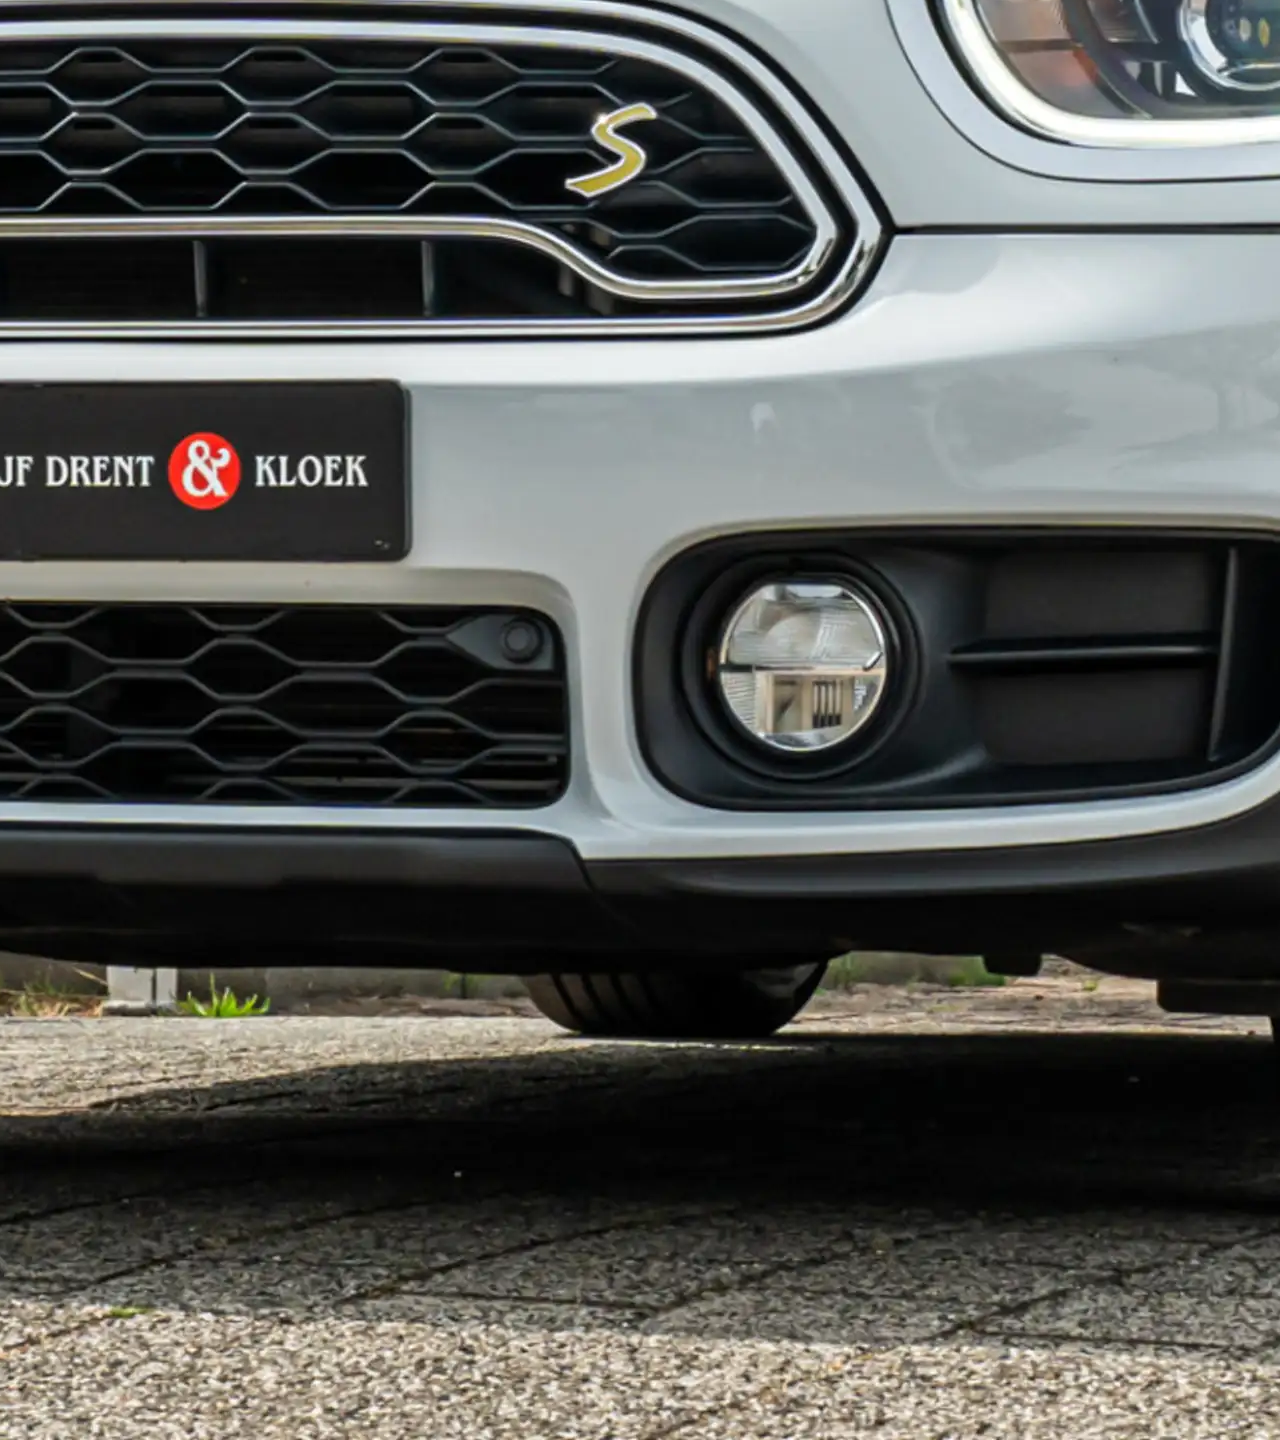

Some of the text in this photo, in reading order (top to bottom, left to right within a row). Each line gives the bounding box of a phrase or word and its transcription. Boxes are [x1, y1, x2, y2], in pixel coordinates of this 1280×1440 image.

[564, 101, 658, 199] S
[45, 455, 155, 488] DRENT
[181, 440, 231, 498] &
[255, 455, 369, 488] KLOEK
